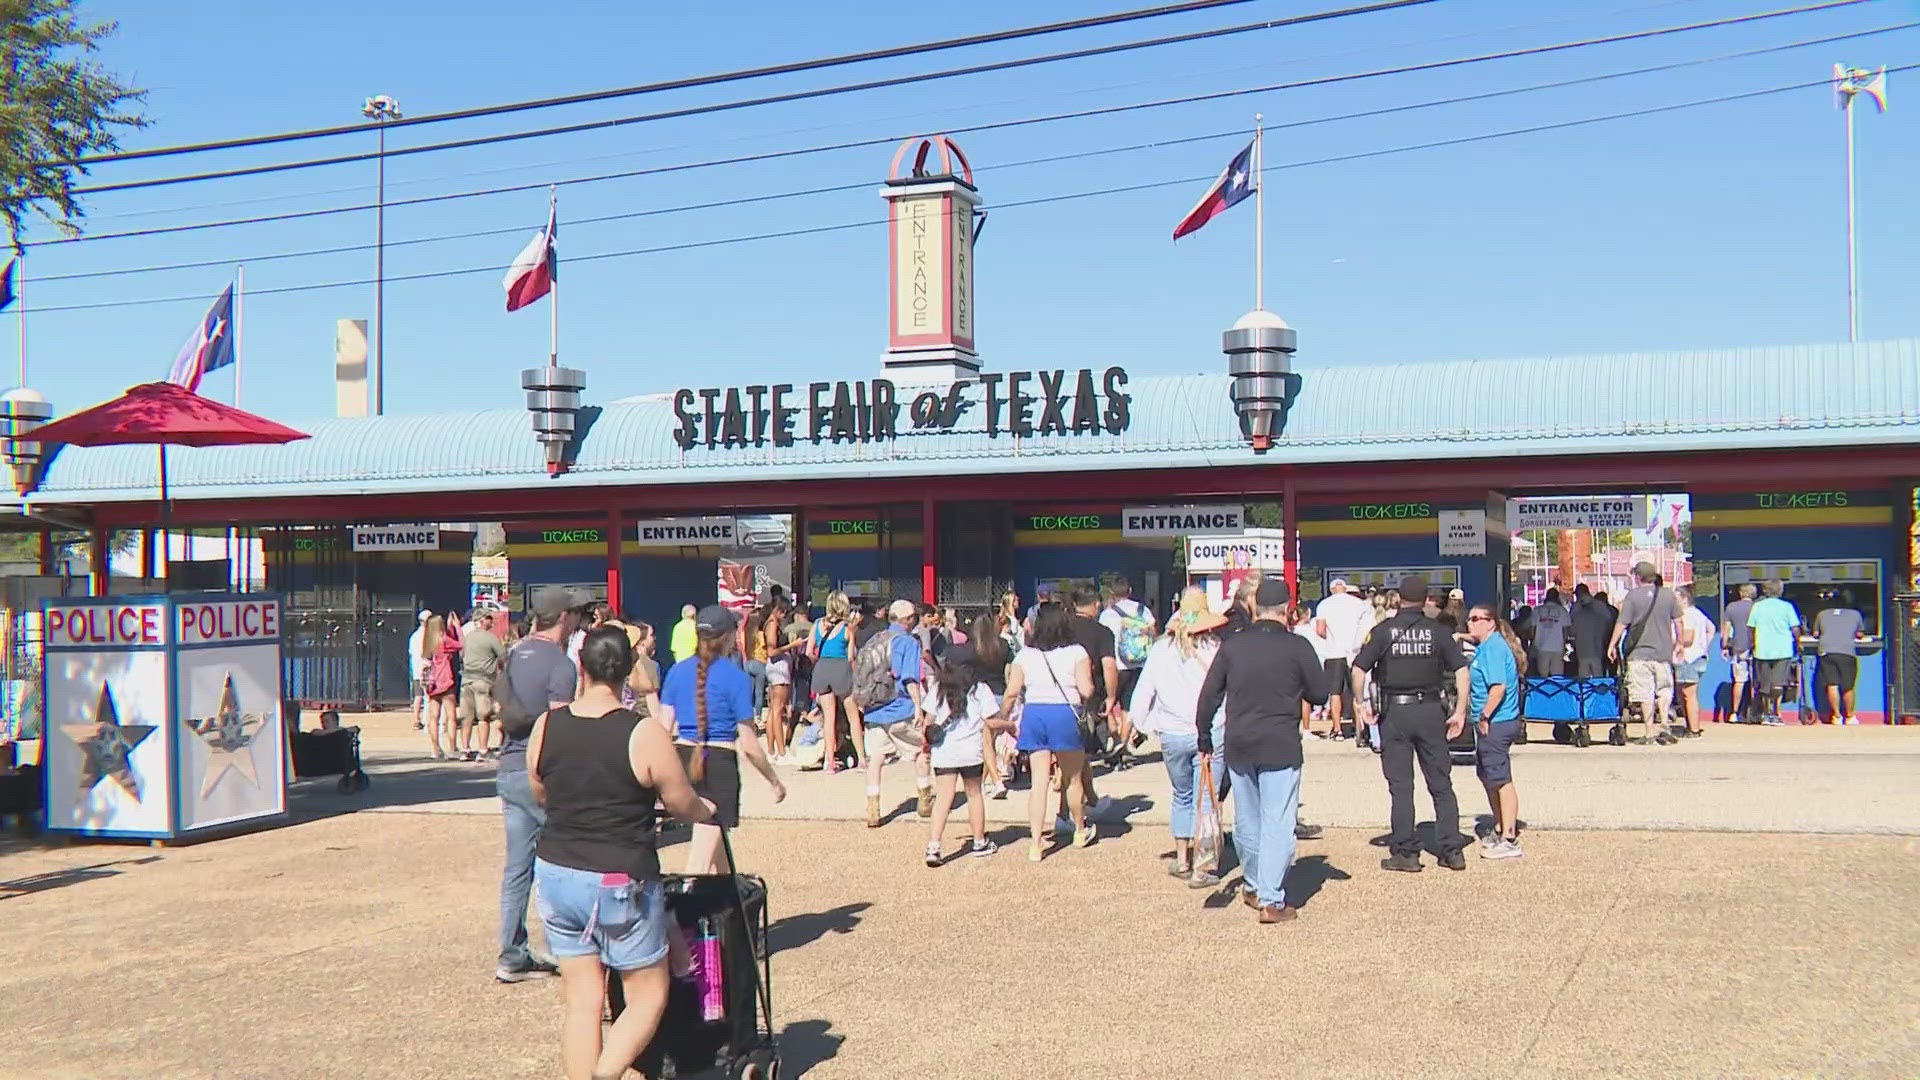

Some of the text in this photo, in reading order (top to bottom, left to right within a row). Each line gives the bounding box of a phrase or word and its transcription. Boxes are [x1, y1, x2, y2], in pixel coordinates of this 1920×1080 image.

[912, 203, 928, 327] ENTRANCE
[957, 207, 966, 331] ENTRANCE
[673, 366, 1128, 449] STATE FAIR of TEXAS
[1755, 491, 1848, 508] TICKETS
[1349, 503, 1430, 519] TICKETS
[1519, 502, 1633, 514] ENTRANCE FOR
[1030, 515, 1101, 530] TICKETS
[1128, 514, 1238, 530] ENTRANCE
[357, 532, 435, 545] ENTRANCE
[541, 529, 599, 543] TICKETS
[642, 525, 732, 540] ENTRANCE
[48, 607, 159, 643] POLICE
[181, 603, 276, 641] POLICE
[1391, 628, 1432, 642] DALLAS
[1392, 643, 1432, 656] POLICE
